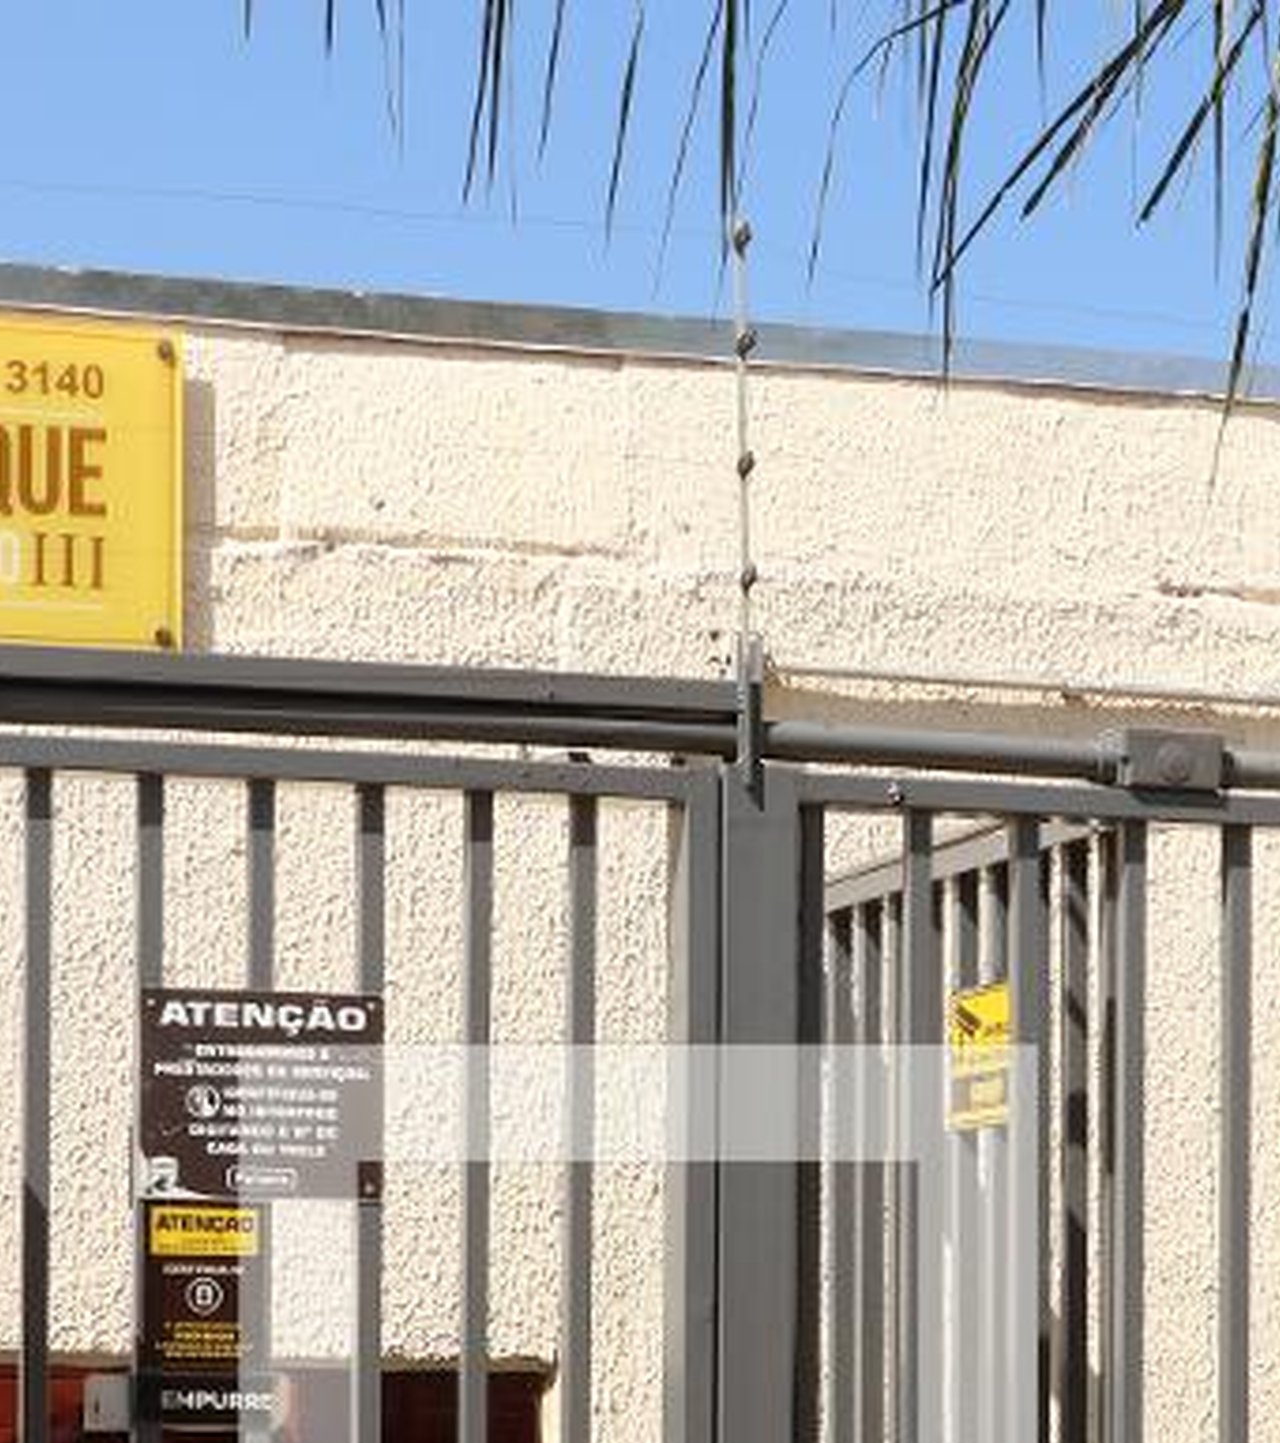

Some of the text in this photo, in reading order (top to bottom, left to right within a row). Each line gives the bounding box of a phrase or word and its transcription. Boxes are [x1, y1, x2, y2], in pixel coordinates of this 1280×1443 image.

[4, 358, 106, 400] 3140
[28, 531, 106, 590] III
[160, 998, 368, 1036] ATENÇÃO
